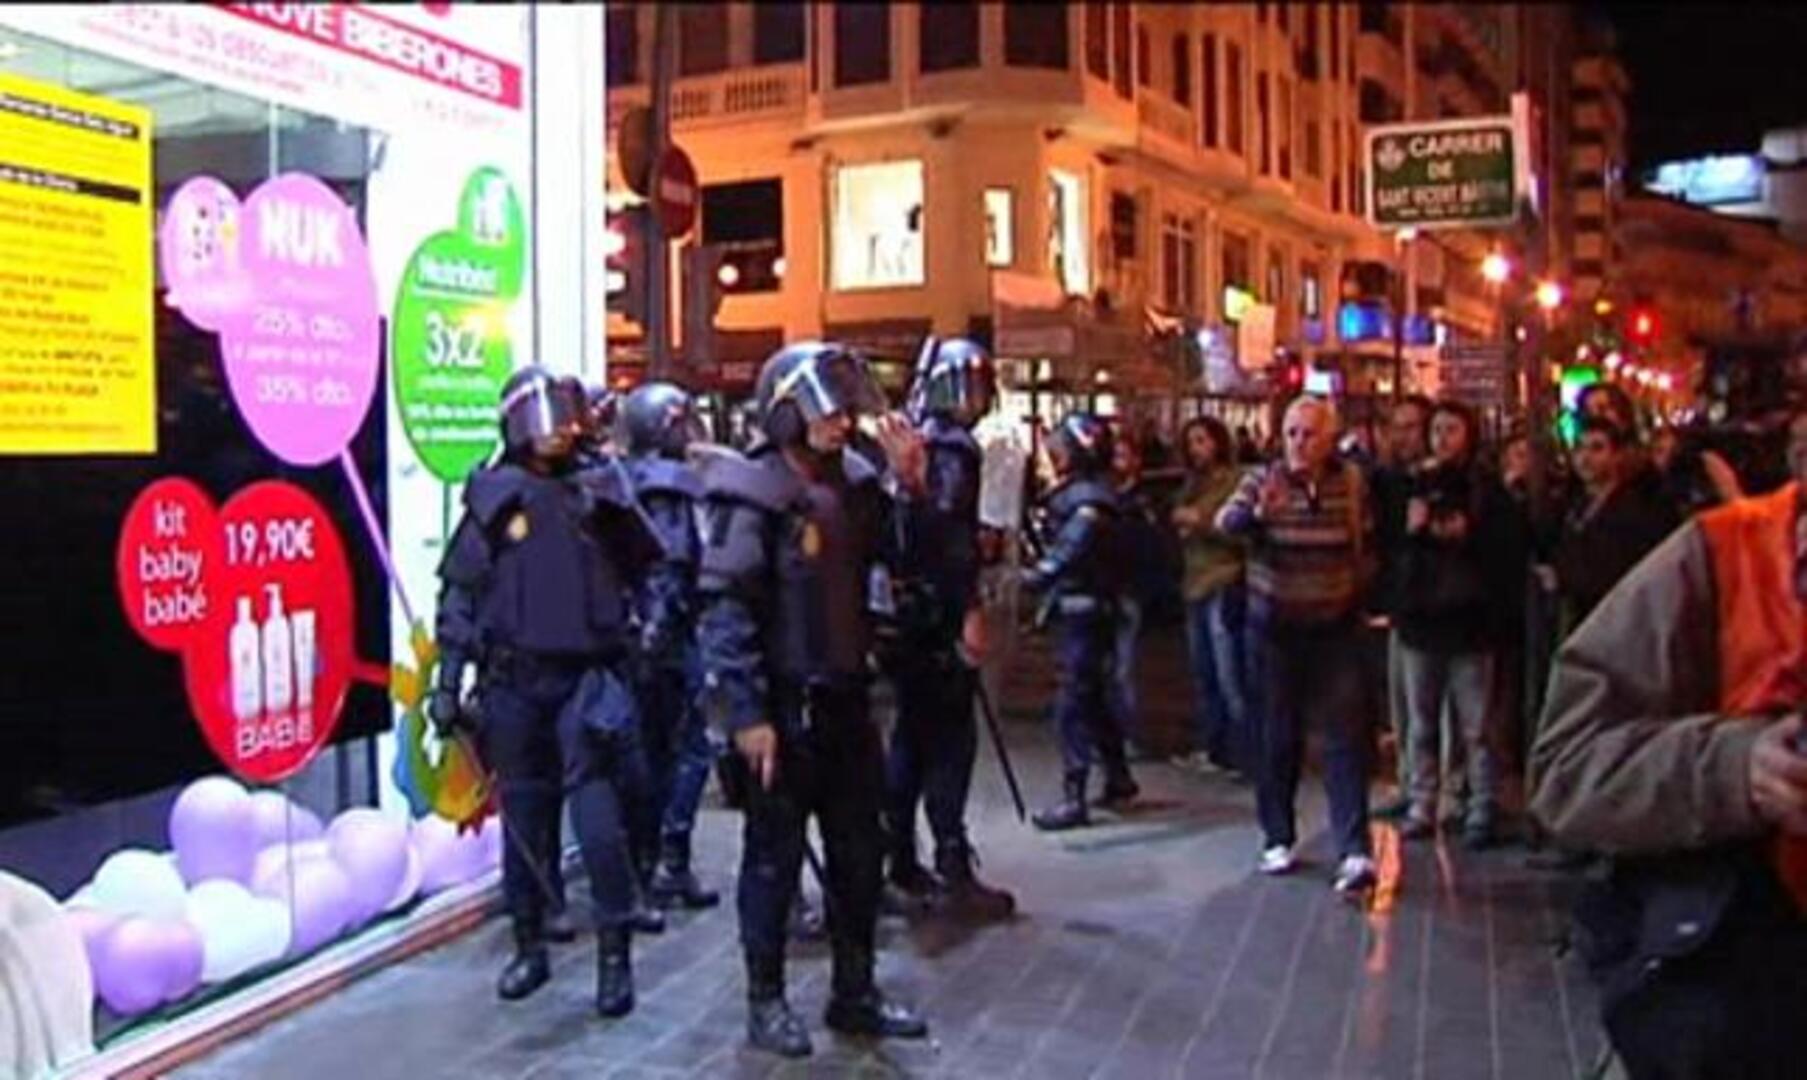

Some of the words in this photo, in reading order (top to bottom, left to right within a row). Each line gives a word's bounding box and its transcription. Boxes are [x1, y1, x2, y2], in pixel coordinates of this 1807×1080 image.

[342, 9, 503, 98] BIBERONES
[1409, 131, 1503, 158] CARRER
[1427, 159, 1454, 182] DE
[258, 200, 344, 268] NUK
[424, 310, 486, 368] 3x2
[257, 376, 306, 402] 35%
[153, 500, 187, 536] kit
[224, 516, 316, 567] 19,90€
[138, 543, 202, 586] baby
[143, 584, 206, 625] babé
